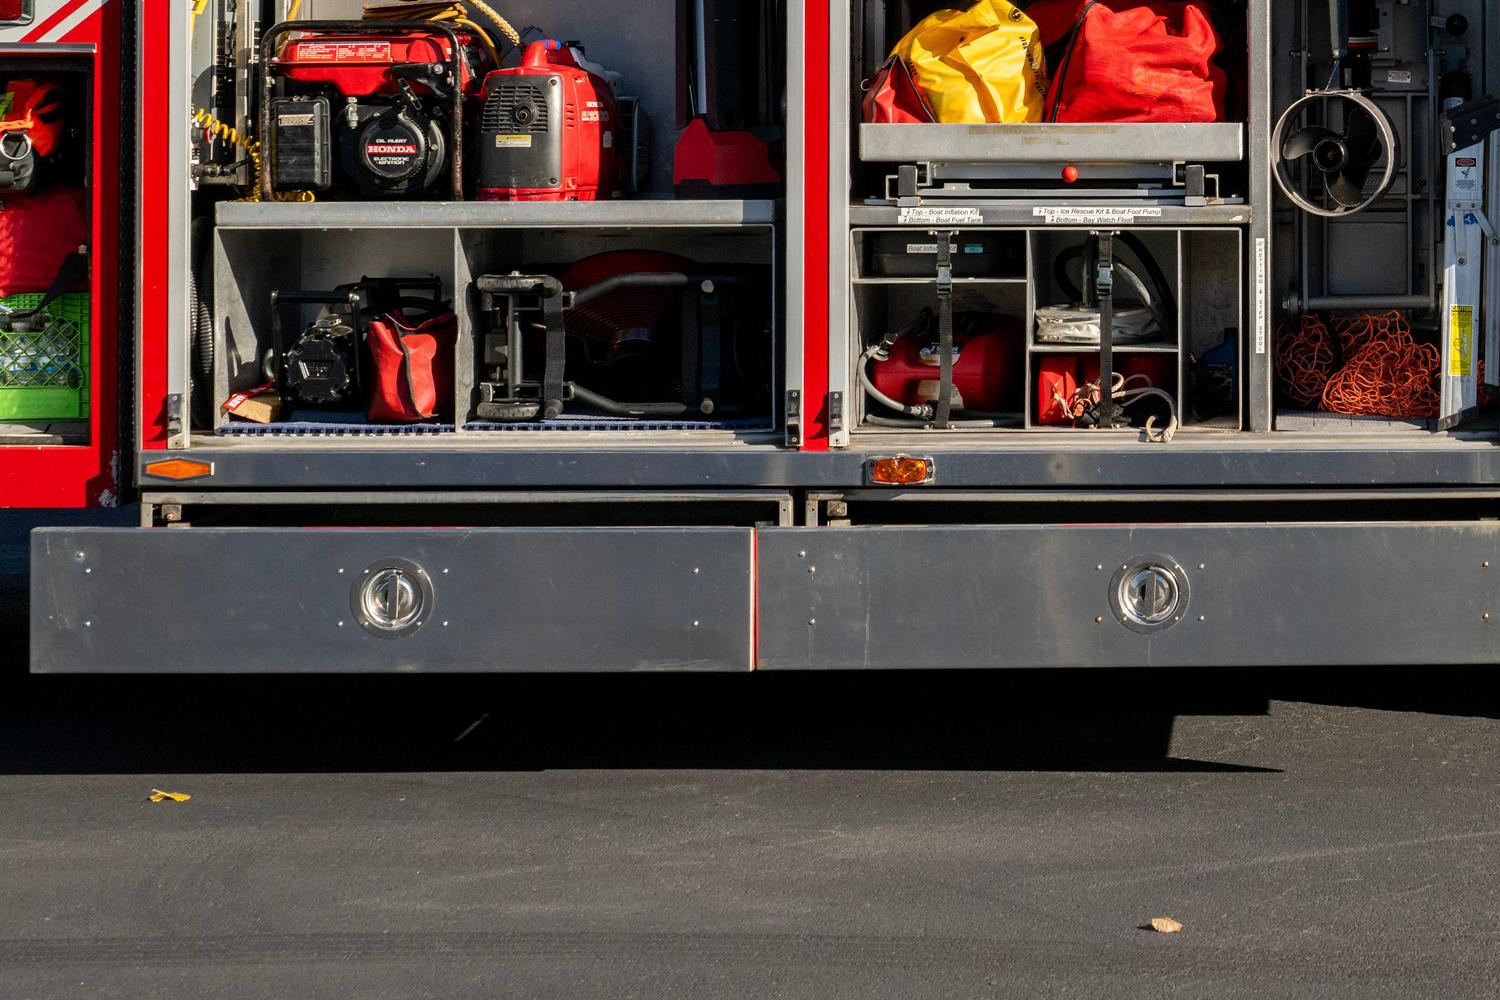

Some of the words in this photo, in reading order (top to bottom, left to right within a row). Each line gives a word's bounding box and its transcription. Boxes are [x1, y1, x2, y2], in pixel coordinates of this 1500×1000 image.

[367, 145, 416, 153] HONDA
[911, 208, 923, 216] Top
[928, 208, 944, 216] Boat
[944, 208, 968, 216] Inflation
[1043, 208, 1055, 216] Top
[1095, 207, 1105, 215] Kit
[1142, 208, 1161, 217] Pump
[1082, 217, 1096, 225] Bay
